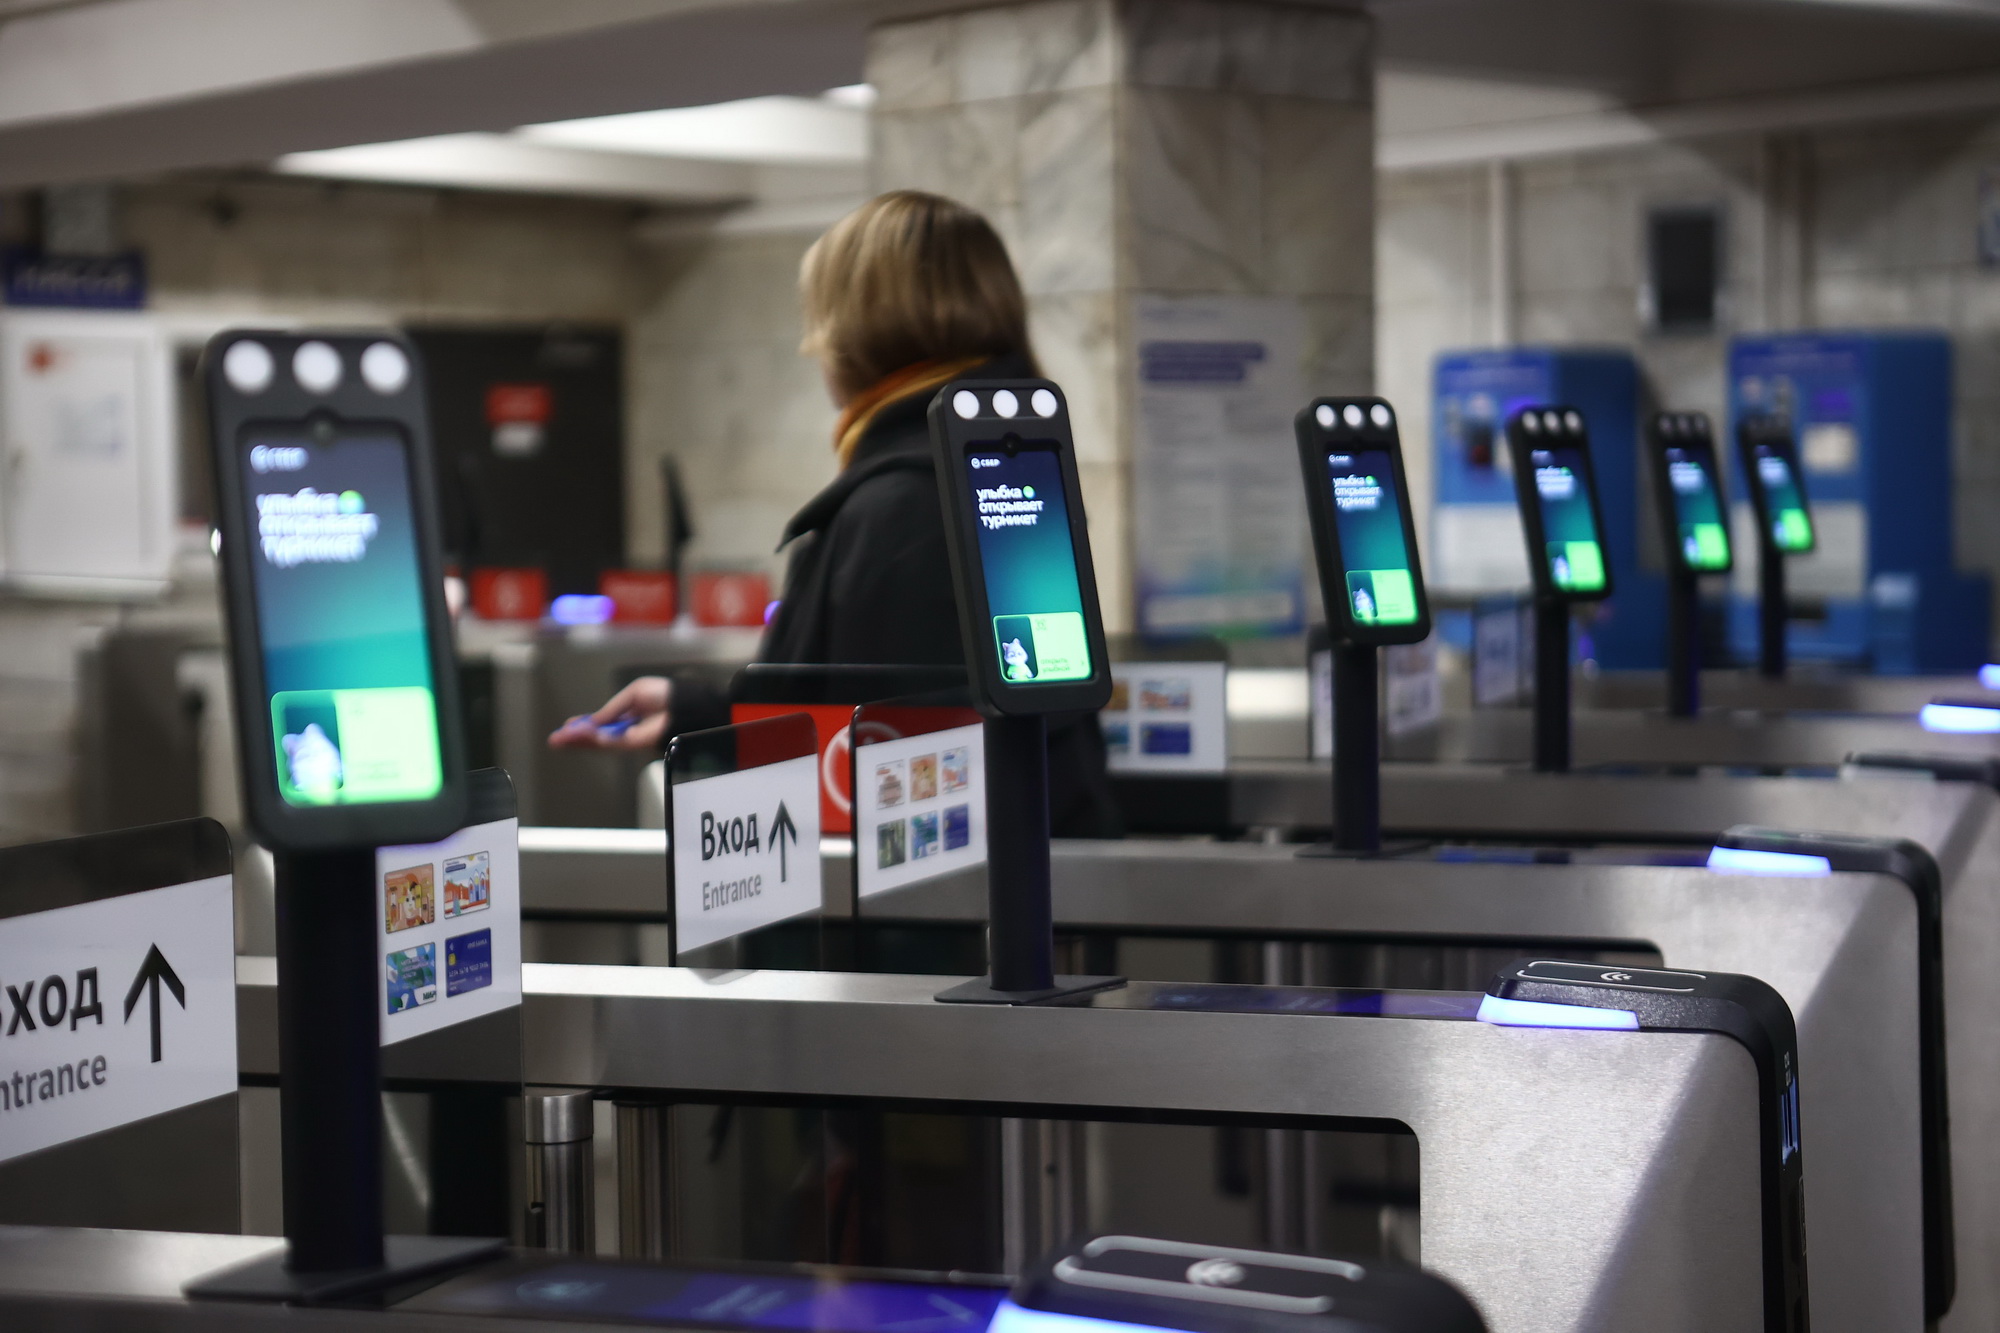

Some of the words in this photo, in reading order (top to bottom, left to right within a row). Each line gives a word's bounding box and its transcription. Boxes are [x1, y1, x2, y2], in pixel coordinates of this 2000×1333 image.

[976, 484, 1023, 502] улыбка
[979, 500, 1044, 514] открывает
[980, 514, 1039, 530] турникет
[701, 810, 760, 861] Вход
[703, 874, 762, 911] Entrance
[0, 966, 103, 1036] ход
[0, 1054, 107, 1111] ntrance
